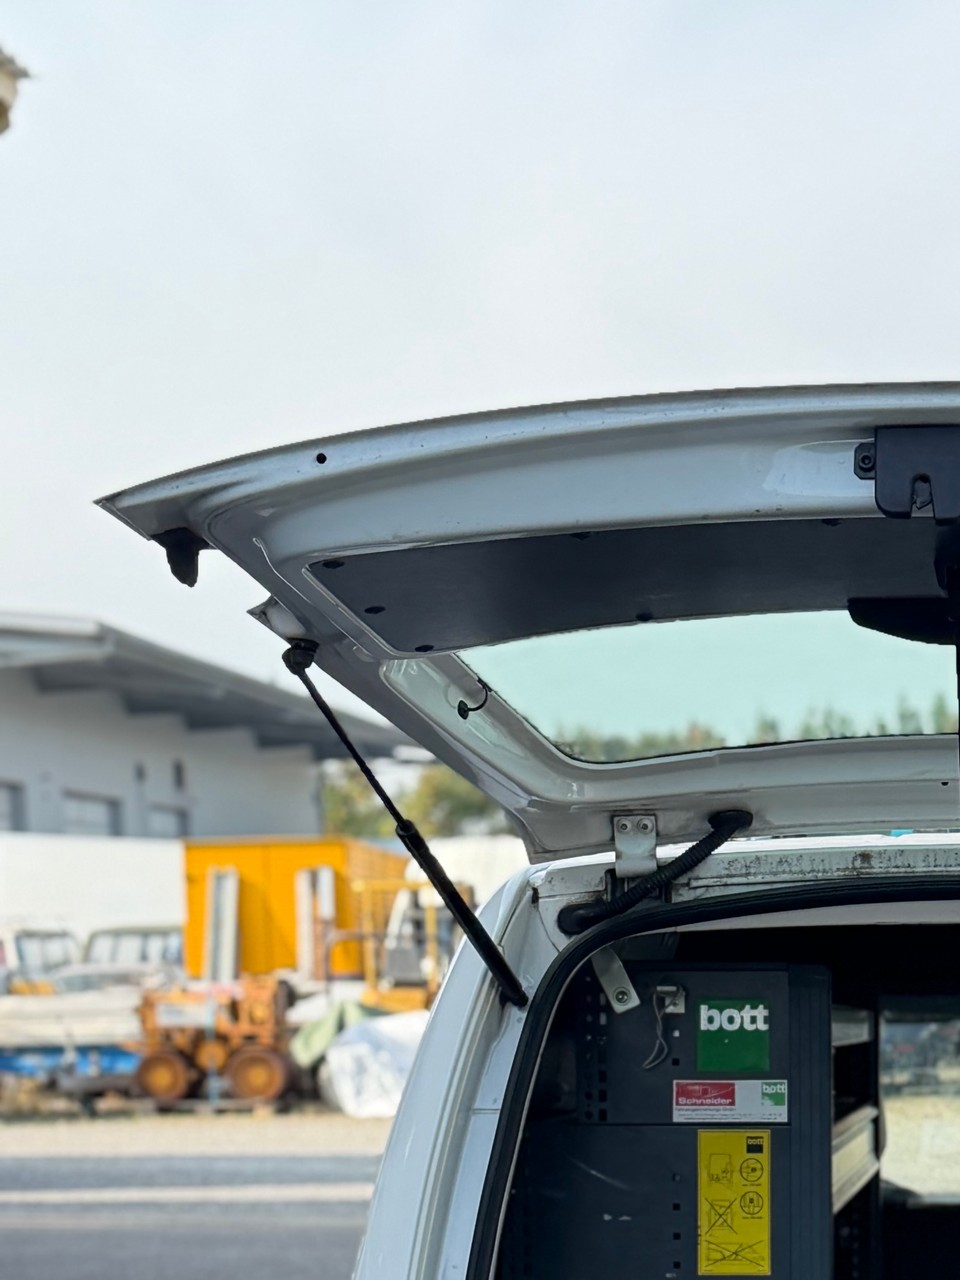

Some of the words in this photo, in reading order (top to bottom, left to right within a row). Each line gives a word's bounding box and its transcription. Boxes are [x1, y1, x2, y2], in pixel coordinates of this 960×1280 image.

[700, 1004, 769, 1031] bott
[762, 1084, 786, 1094] bott
[678, 1097, 732, 1105] Schneider
